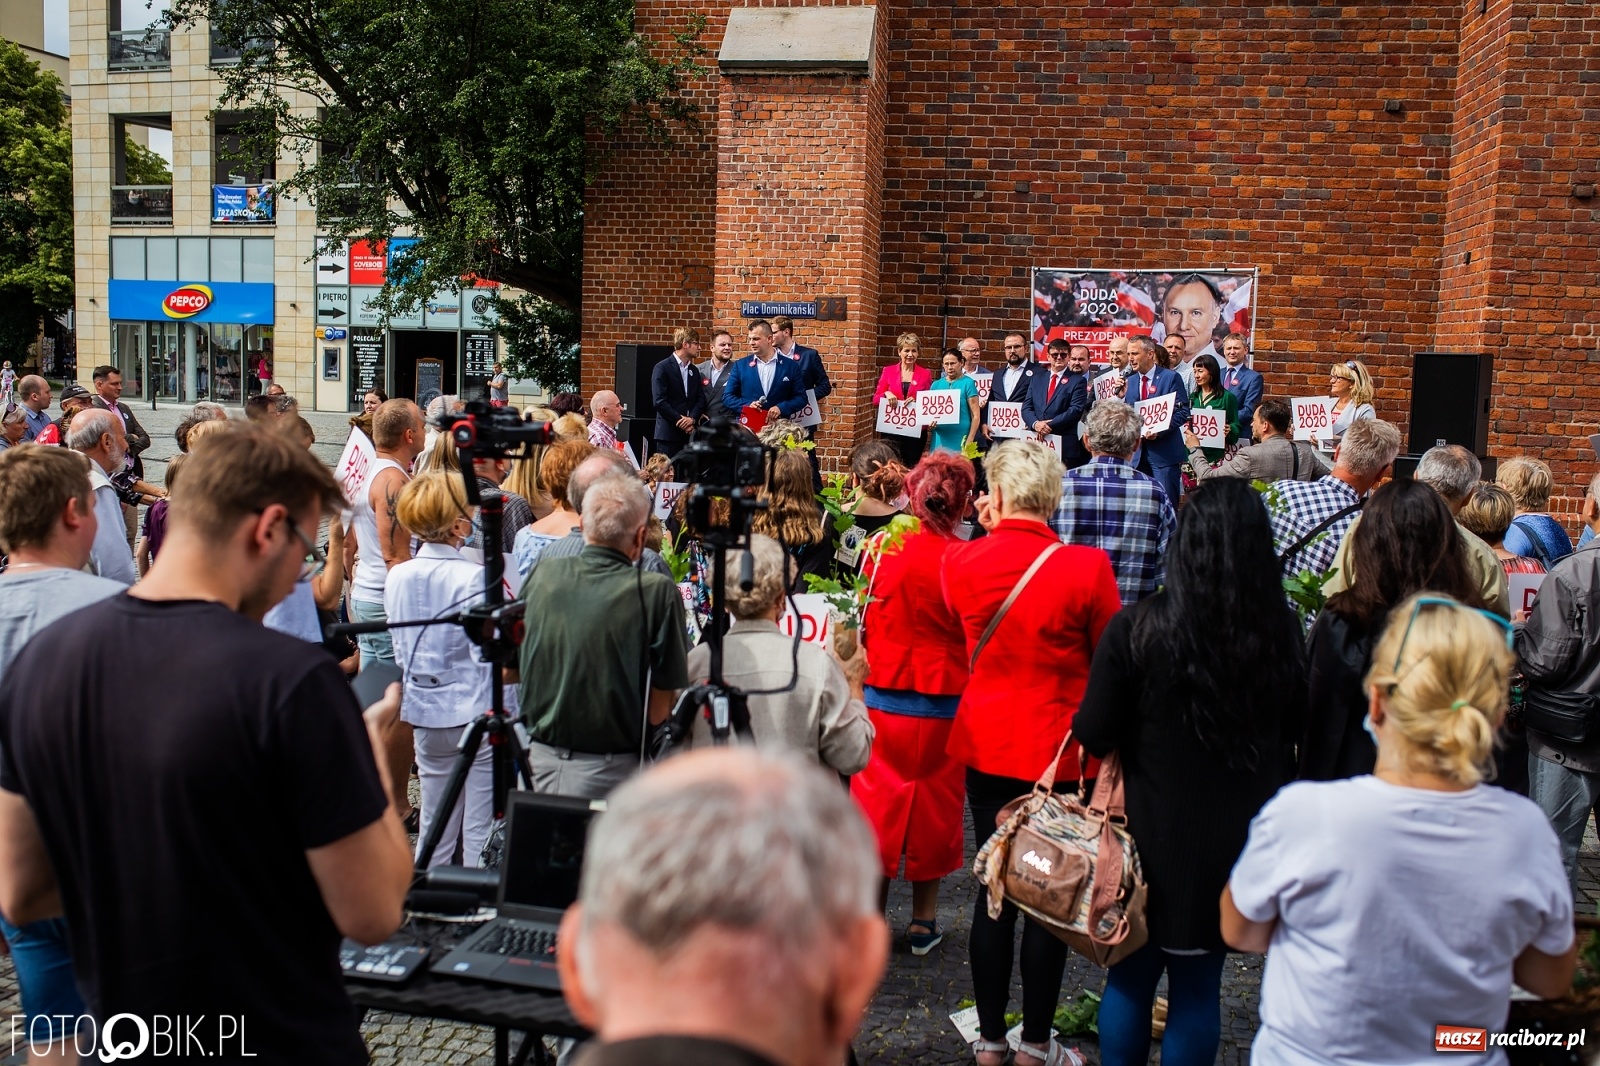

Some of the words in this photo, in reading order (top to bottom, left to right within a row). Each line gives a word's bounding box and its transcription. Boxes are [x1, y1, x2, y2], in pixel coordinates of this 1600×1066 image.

[322, 293, 348, 302] PIĘTRO
[1080, 288, 1119, 301] DUDA
[169, 295, 204, 308] PEPCO
[742, 302, 759, 315] Plac
[761, 303, 815, 316] Dominikański
[1080, 302, 1119, 315] 2020
[1063, 330, 1130, 342] PREZYDENT
[1096, 376, 1116, 393] DUDA
[922, 395, 954, 406] DUDA
[885, 404, 917, 418] DUDA
[922, 404, 954, 416] 2020
[992, 407, 1020, 418] DUDA
[1140, 401, 1168, 417] DUDA
[1298, 403, 1326, 417] DUDA
[884, 414, 917, 427] 2020
[992, 417, 1020, 428] 2020
[1143, 411, 1168, 426] 020
[1191, 414, 1218, 427] UDA
[1299, 415, 1327, 428] 2020
